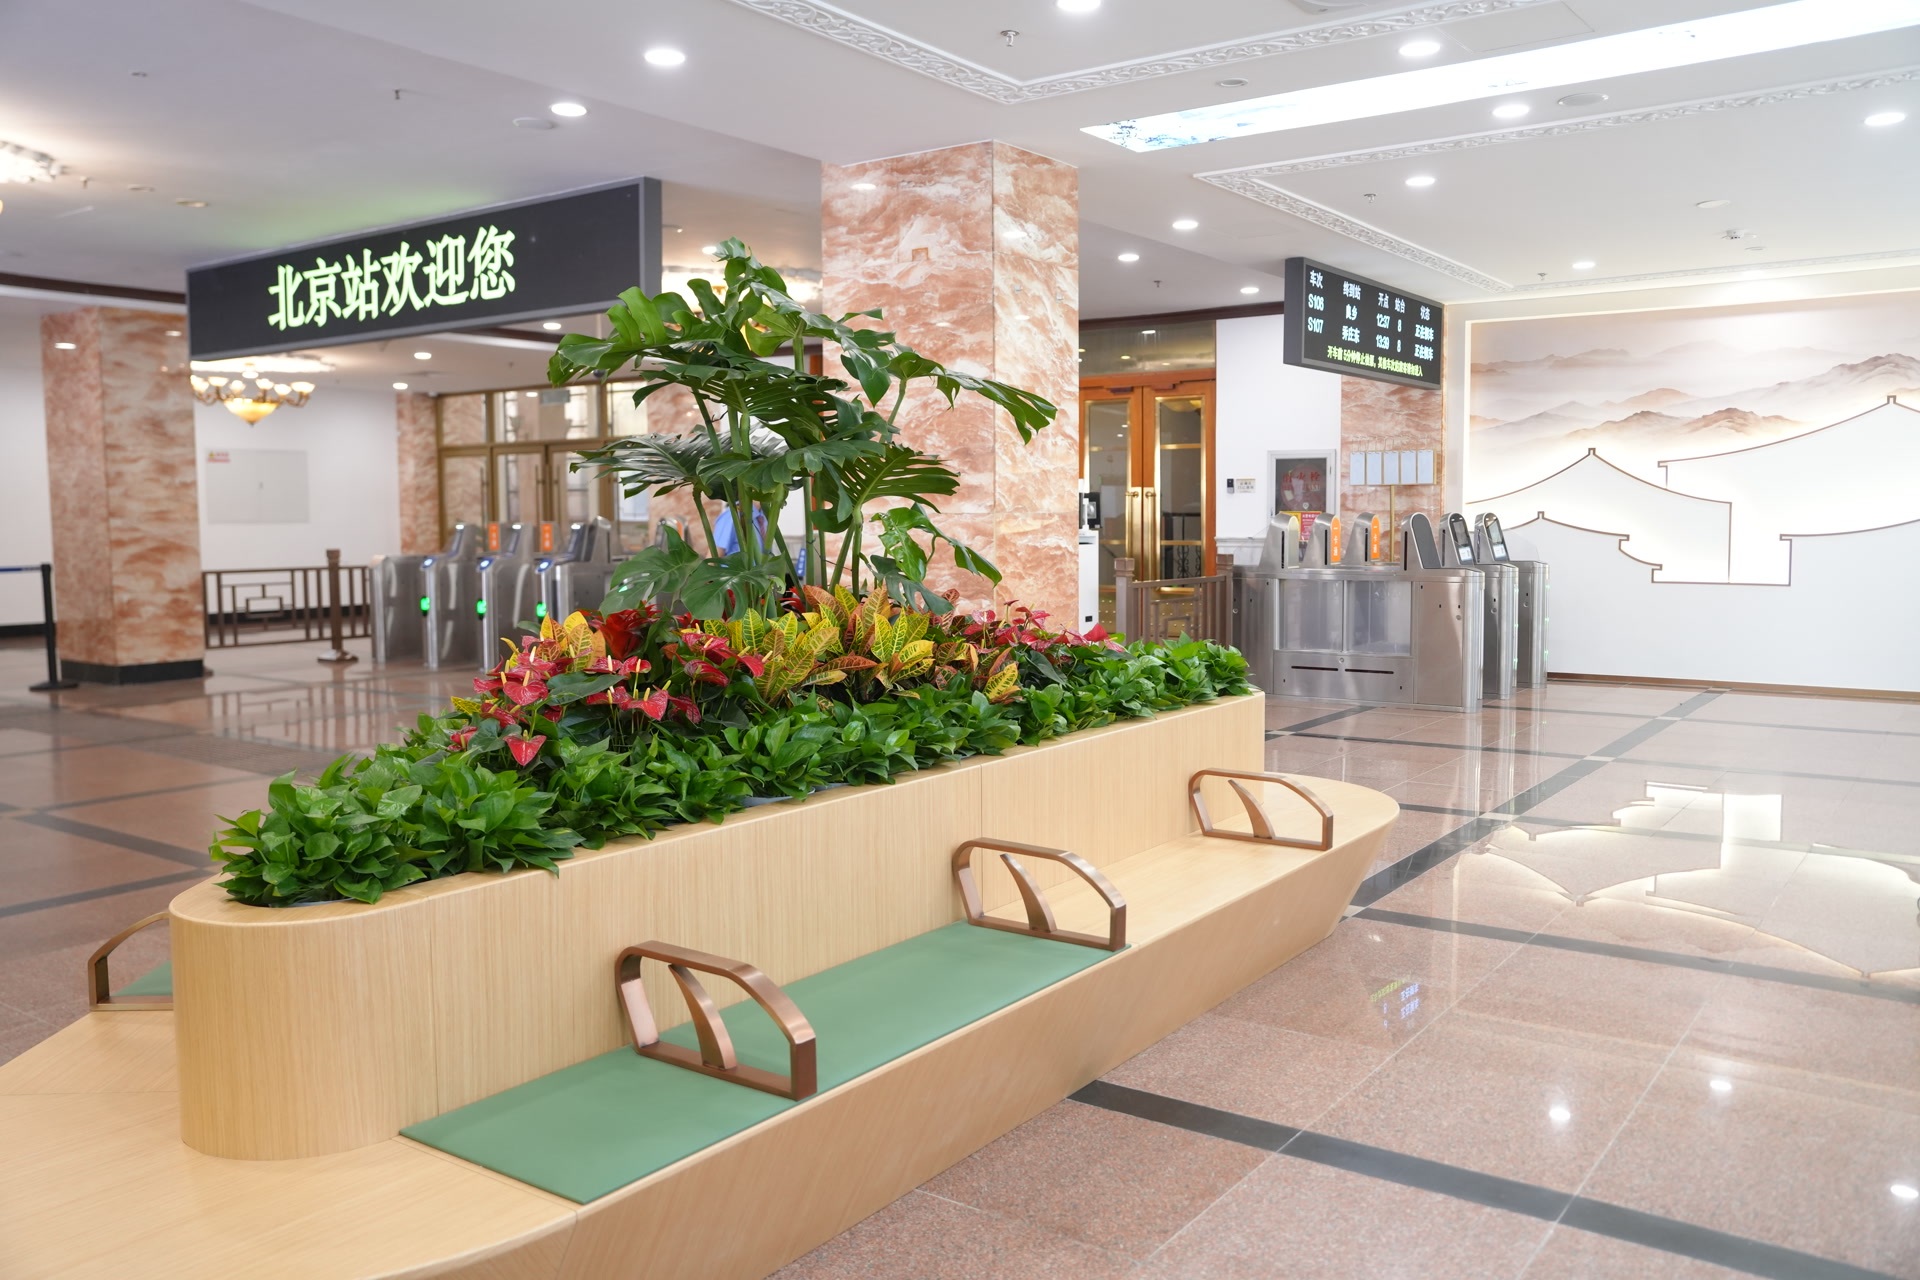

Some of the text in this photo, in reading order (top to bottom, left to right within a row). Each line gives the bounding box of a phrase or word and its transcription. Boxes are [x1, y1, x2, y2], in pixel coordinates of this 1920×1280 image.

[267, 225, 516, 331] 北京站欢迎您
[1309, 270, 1323, 289] 车次
[1343, 281, 1361, 300] 终到站
[1378, 292, 1389, 309] 开点
[1395, 297, 1405, 313] 站台
[1308, 317, 1323, 333] S107
[1345, 304, 1357, 320] 良乡
[1397, 319, 1402, 333] 8
